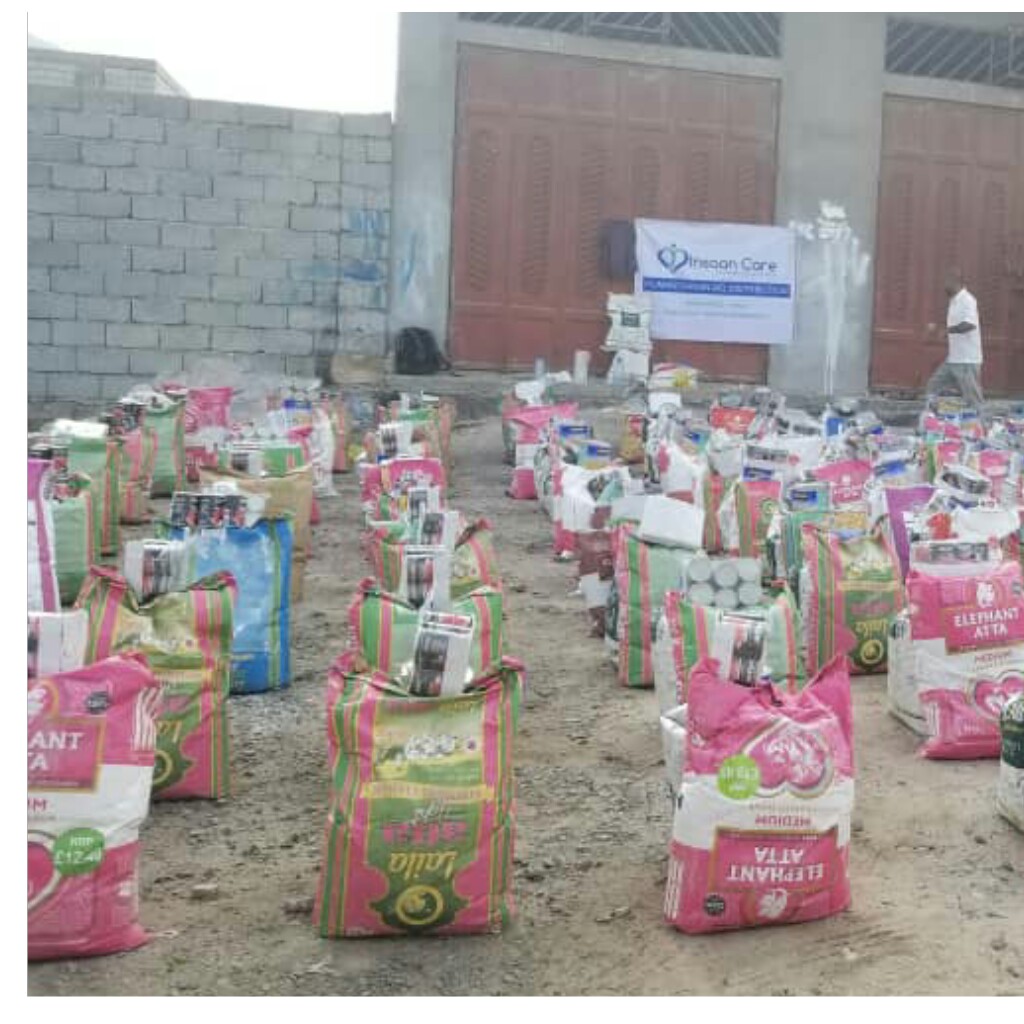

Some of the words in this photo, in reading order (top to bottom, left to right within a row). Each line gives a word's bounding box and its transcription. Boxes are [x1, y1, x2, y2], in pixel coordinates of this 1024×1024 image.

[689, 255, 738, 271] Insaan
[741, 257, 778, 273] Care
[954, 607, 1020, 628] ELEPHANT
[974, 624, 1009, 640] ATTA
[755, 815, 812, 826] MEDIUM
[754, 846, 804, 864] ATTA
[389, 851, 458, 880] Laila
[727, 862, 824, 882] ELEPHANT
